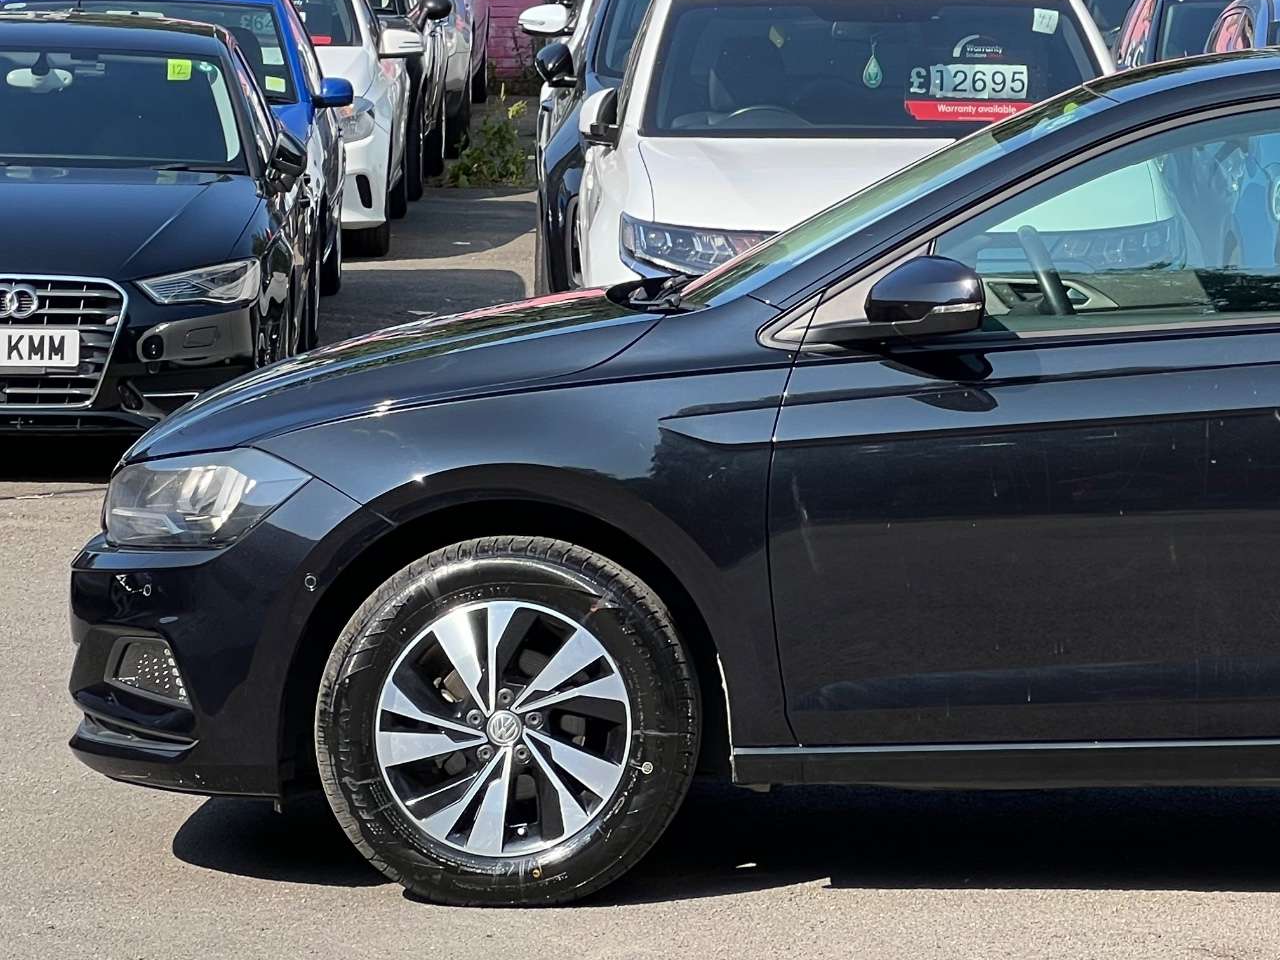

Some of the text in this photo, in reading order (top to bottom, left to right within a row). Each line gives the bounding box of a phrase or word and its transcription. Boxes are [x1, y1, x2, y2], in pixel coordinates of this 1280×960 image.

[910, 66, 1026, 94] £12695
[937, 104, 1017, 115] Warranty available
[7, 334, 66, 361] KMM
